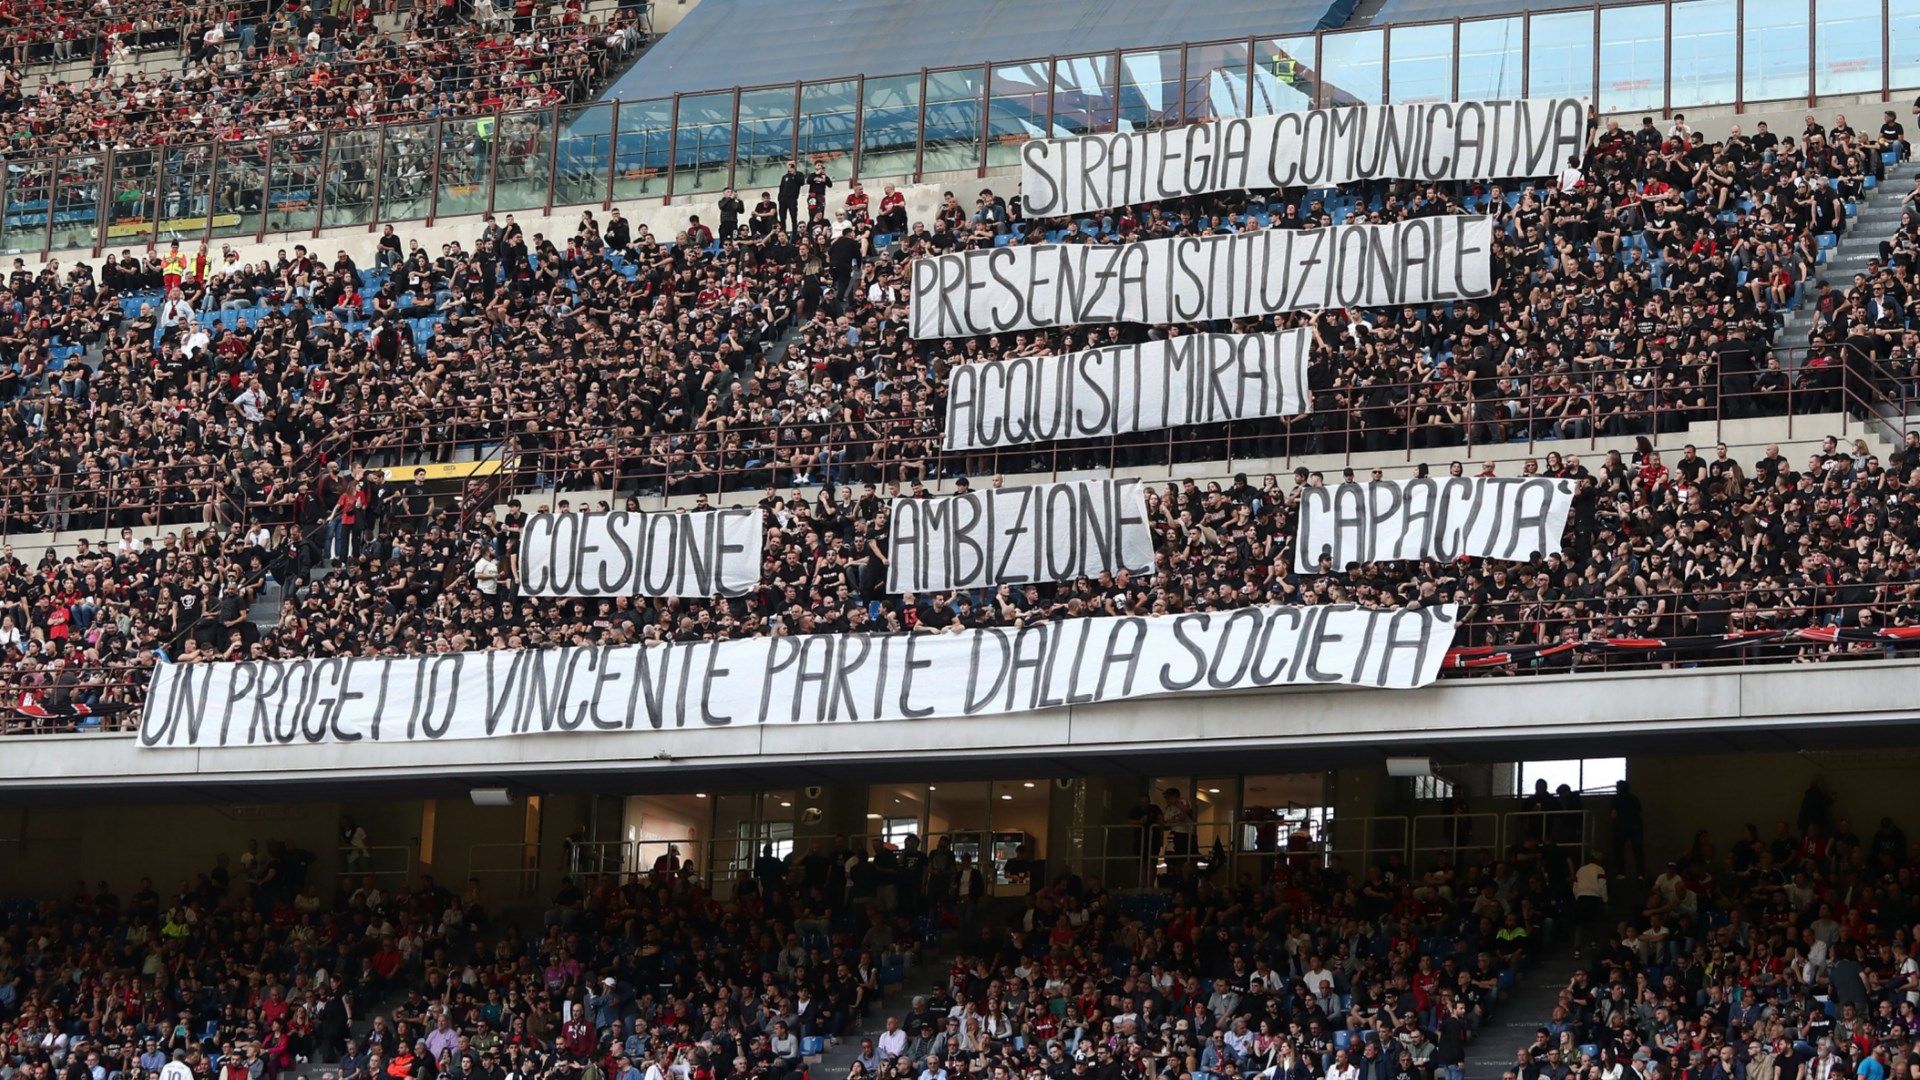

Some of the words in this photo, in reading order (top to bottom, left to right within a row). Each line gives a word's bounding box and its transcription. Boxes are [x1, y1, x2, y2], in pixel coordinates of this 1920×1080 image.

[1021, 117, 1252, 217] STRATEGIA
[1268, 97, 1584, 186] COMUNICATIVA
[912, 240, 1149, 339] PRESENZA
[1166, 214, 1490, 323] ISTITUZIONALE
[946, 344, 1142, 449] ACQUISTI
[1161, 326, 1311, 428] MIRATI
[520, 508, 762, 597] COESIONE
[888, 477, 1152, 593] AMBIZIONE
[141, 660, 213, 747] UN
[219, 652, 464, 746] PROGETTO
[485, 639, 732, 736] VINCENTE
[758, 631, 935, 723] PARTE
[964, 616, 1148, 716] DALLA
[167, 1070, 182, 1080] 10
